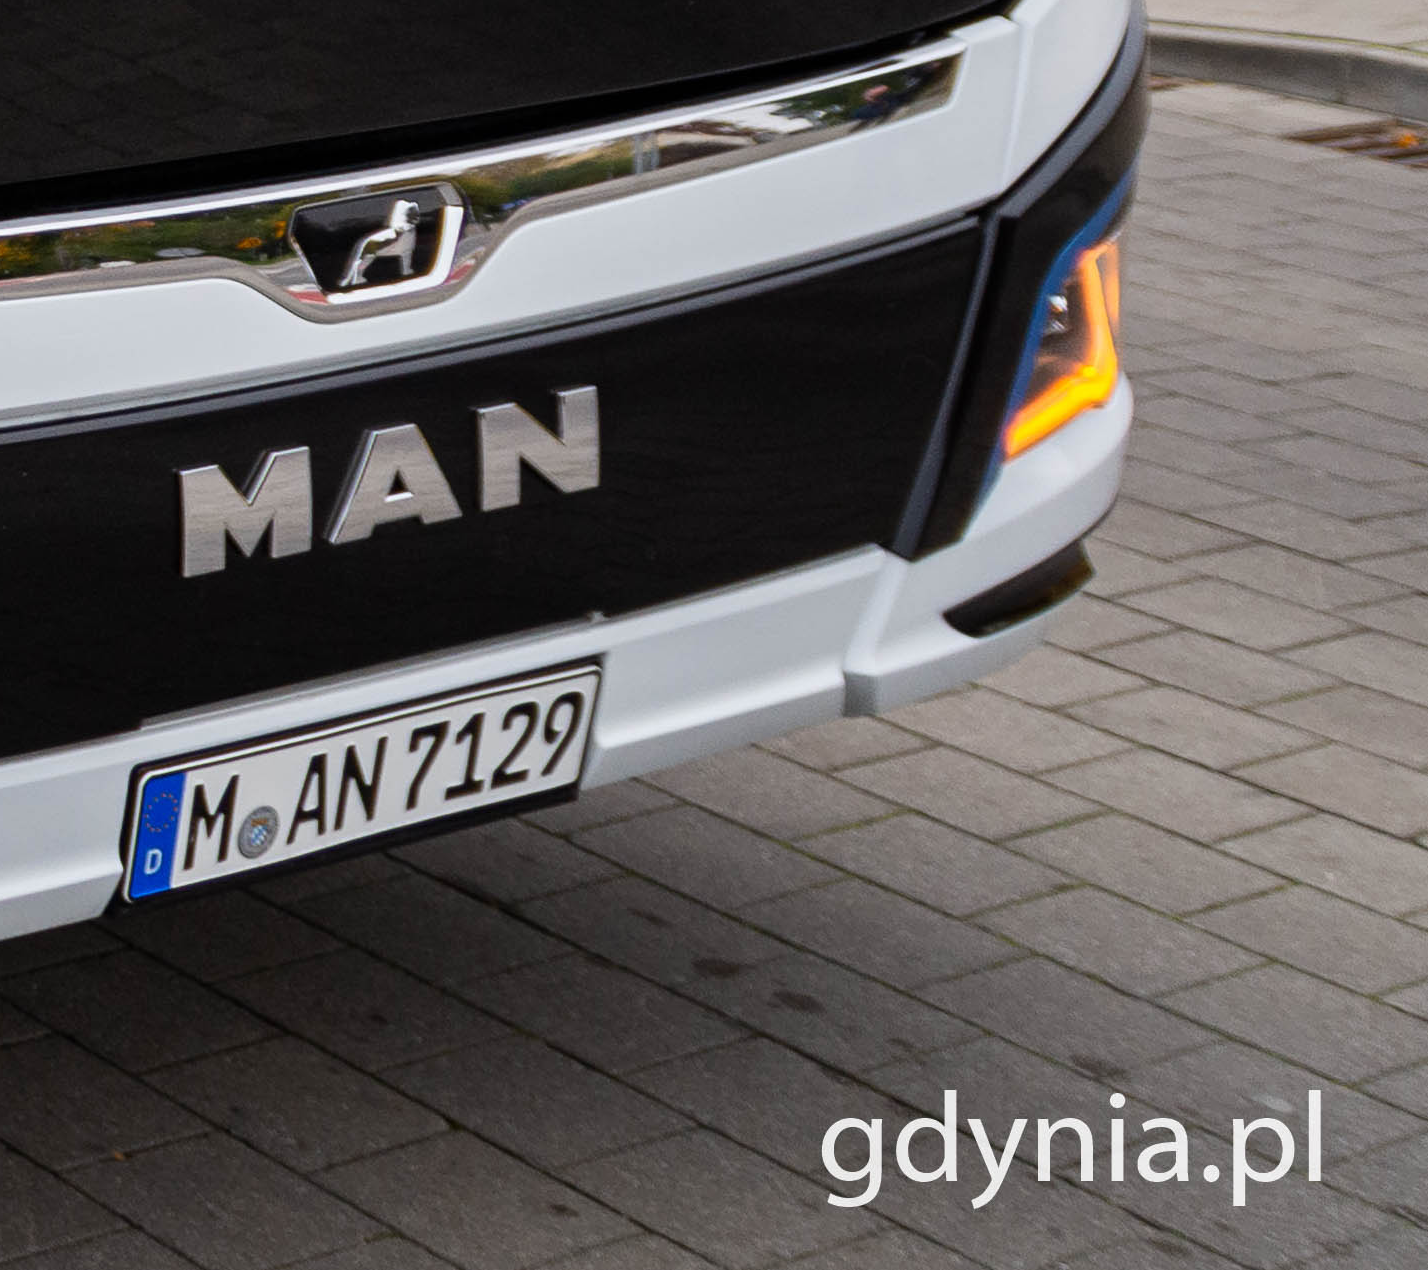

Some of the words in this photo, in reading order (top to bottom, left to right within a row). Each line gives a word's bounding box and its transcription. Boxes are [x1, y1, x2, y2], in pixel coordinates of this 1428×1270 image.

[175, 384, 602, 579] MAN
[145, 848, 163, 877] D
[182, 774, 240, 871] M
